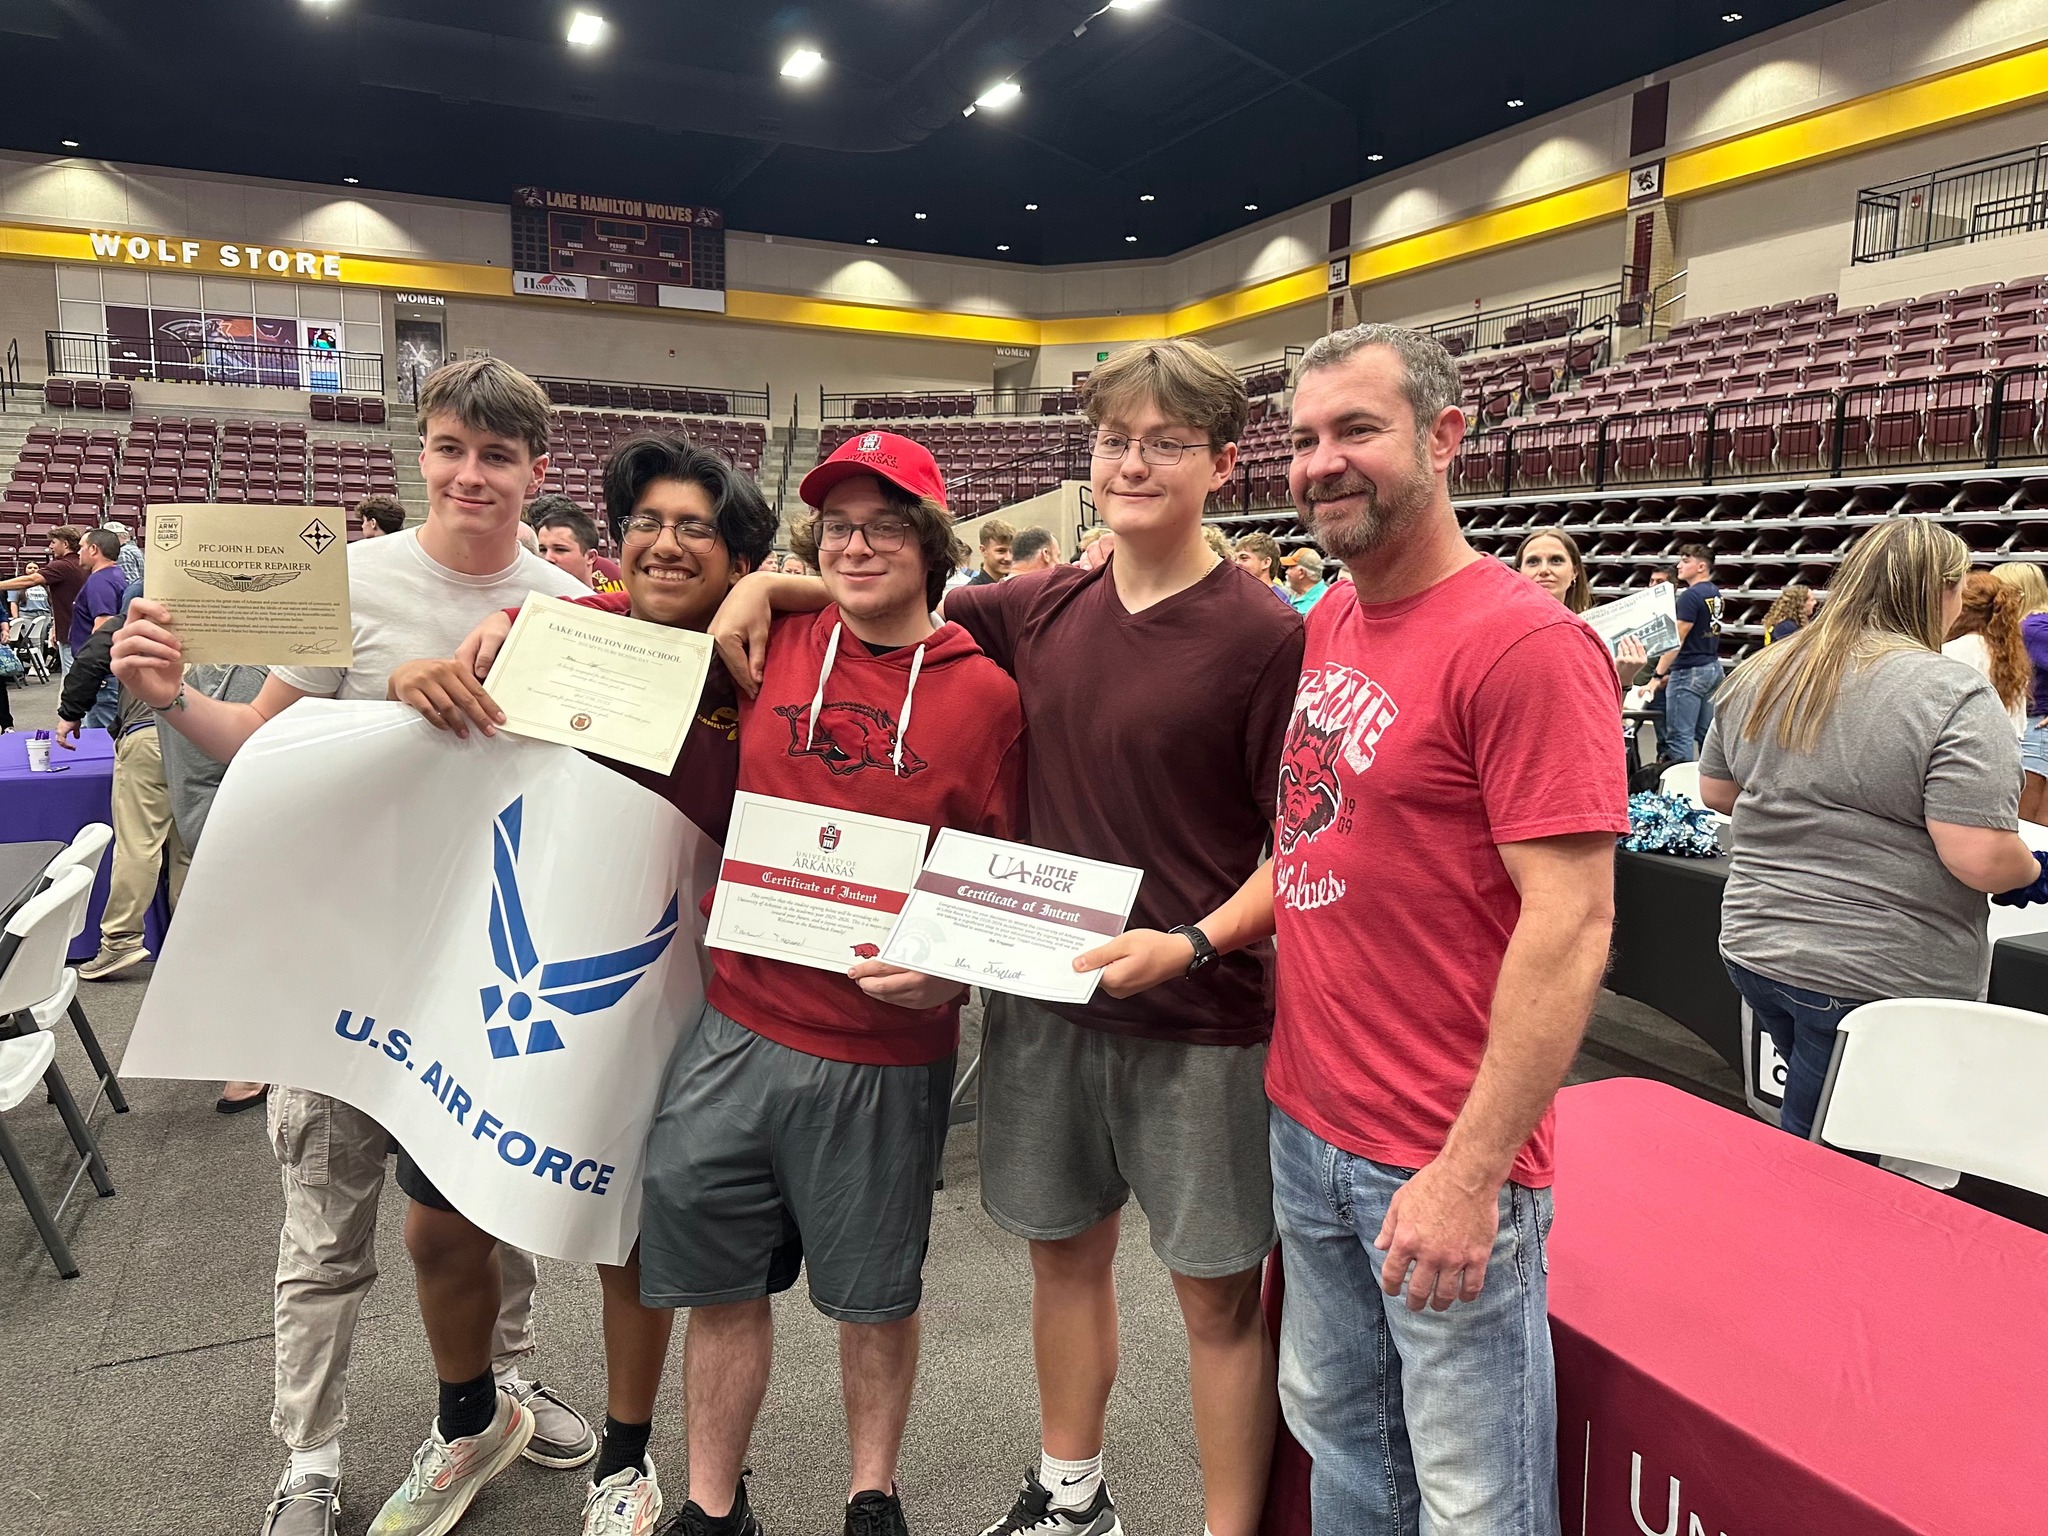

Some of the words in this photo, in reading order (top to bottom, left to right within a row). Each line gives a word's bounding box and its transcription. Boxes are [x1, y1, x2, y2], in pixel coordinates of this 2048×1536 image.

[546, 191, 577, 209] LAKE
[580, 195, 642, 217] HAMILTON
[644, 202, 693, 223] WOLVES
[90, 232, 200, 264] WOLF
[219, 244, 341, 278] STORE
[609, 261, 633, 269] TIMEOUTS
[523, 277, 577, 293] HOMETOWN
[396, 292, 445, 306] WOMEN
[996, 347, 1031, 358] WOMEN
[198, 544, 216, 553] PFC
[217, 544, 243, 553] JOHN
[245, 545, 255, 554] H.
[257, 546, 285, 554] DEAN
[174, 559, 201, 568] UH-60
[202, 560, 262, 570] HELICOPTER
[264, 562, 312, 571] REPAIRER
[548, 622, 574, 636] LAKE
[574, 627, 622, 649] HAMILTON
[622, 643, 647, 656] HIGH
[647, 649, 682, 664] SCHOOL
[1344, 797, 1356, 816] 19
[1337, 816, 1353, 835] 09
[792, 857, 855, 878] ARKANSAS
[796, 851, 844, 865] UNIVERSITY
[988, 853, 1032, 884] UA
[1036, 863, 1078, 882] LITTLE
[761, 871, 821, 893] Certificate
[823, 884, 837, 895] of
[837, 885, 878, 904] Intent
[1031, 875, 1075, 894] ROCK
[957, 885, 1019, 909] Certificate
[1021, 900, 1037, 913] of
[1039, 903, 1081, 923] Intent
[334, 1009, 414, 1071] U.S.
[420, 1060, 473, 1126] AIR
[471, 1109, 616, 1196] FORCE
